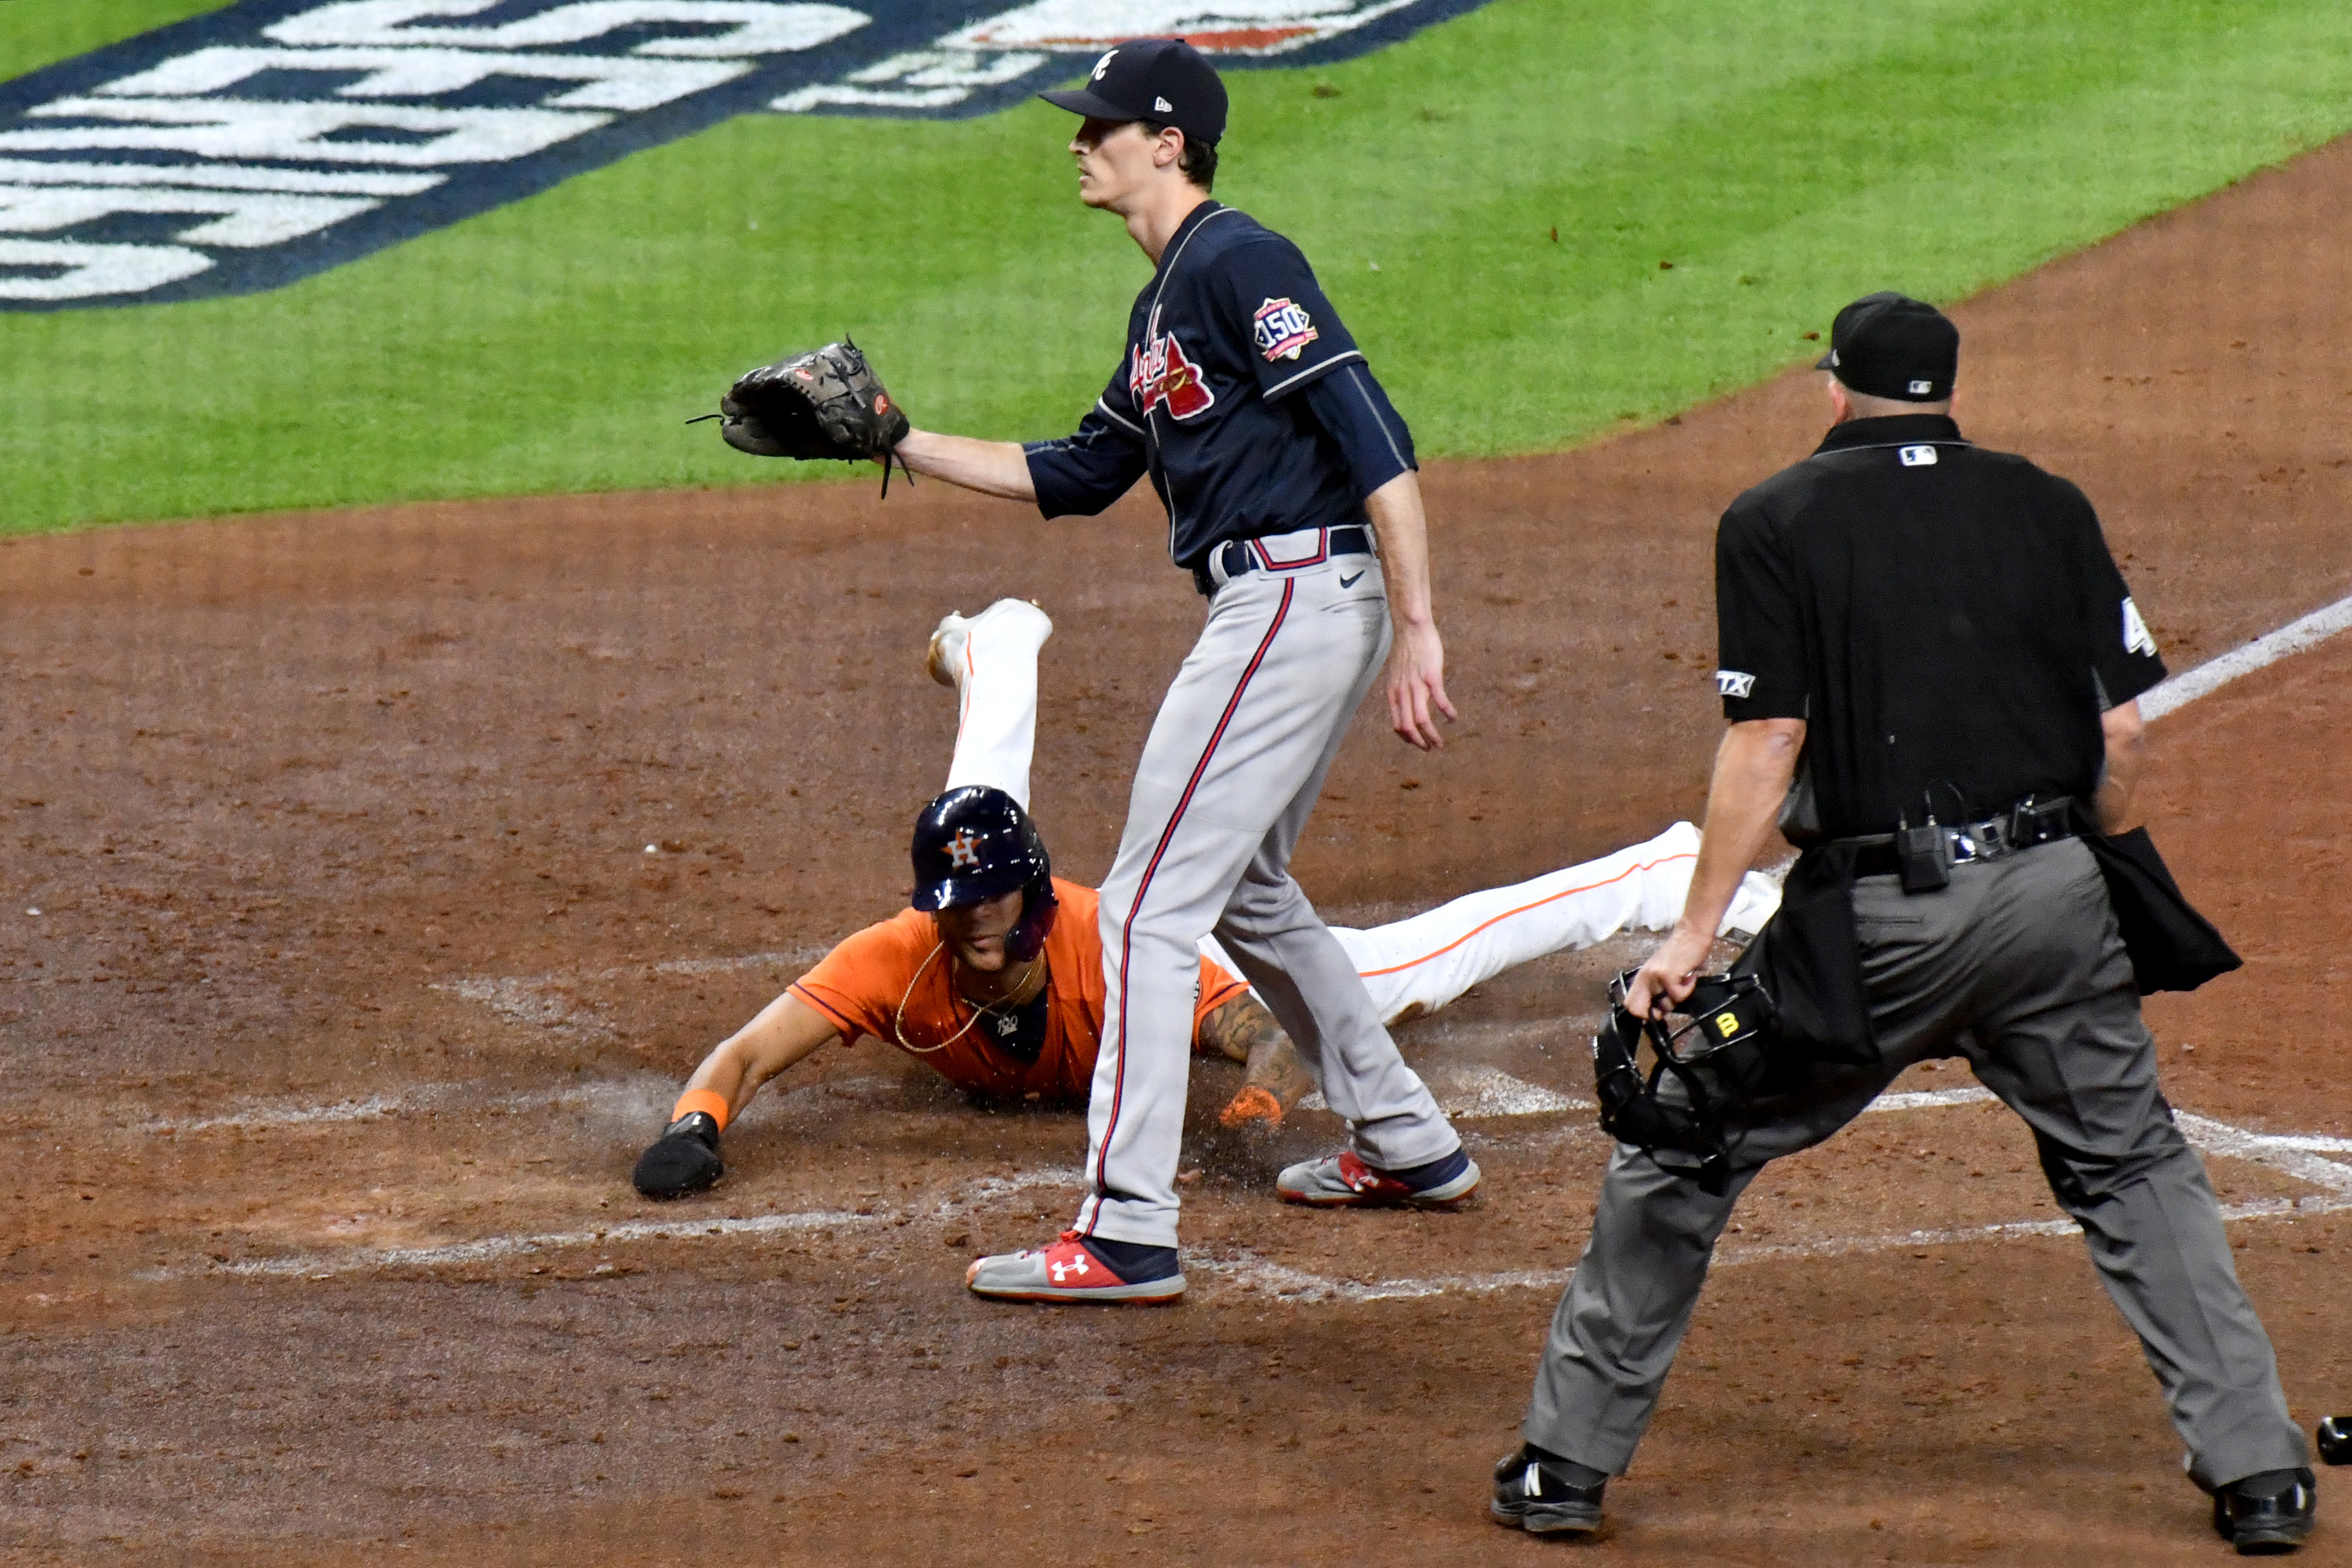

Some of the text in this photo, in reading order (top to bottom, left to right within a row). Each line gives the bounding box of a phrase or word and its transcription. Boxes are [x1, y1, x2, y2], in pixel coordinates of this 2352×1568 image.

[1254, 305, 1304, 348] 150
[1715, 673, 1752, 696] TX
[947, 836, 979, 868] H
